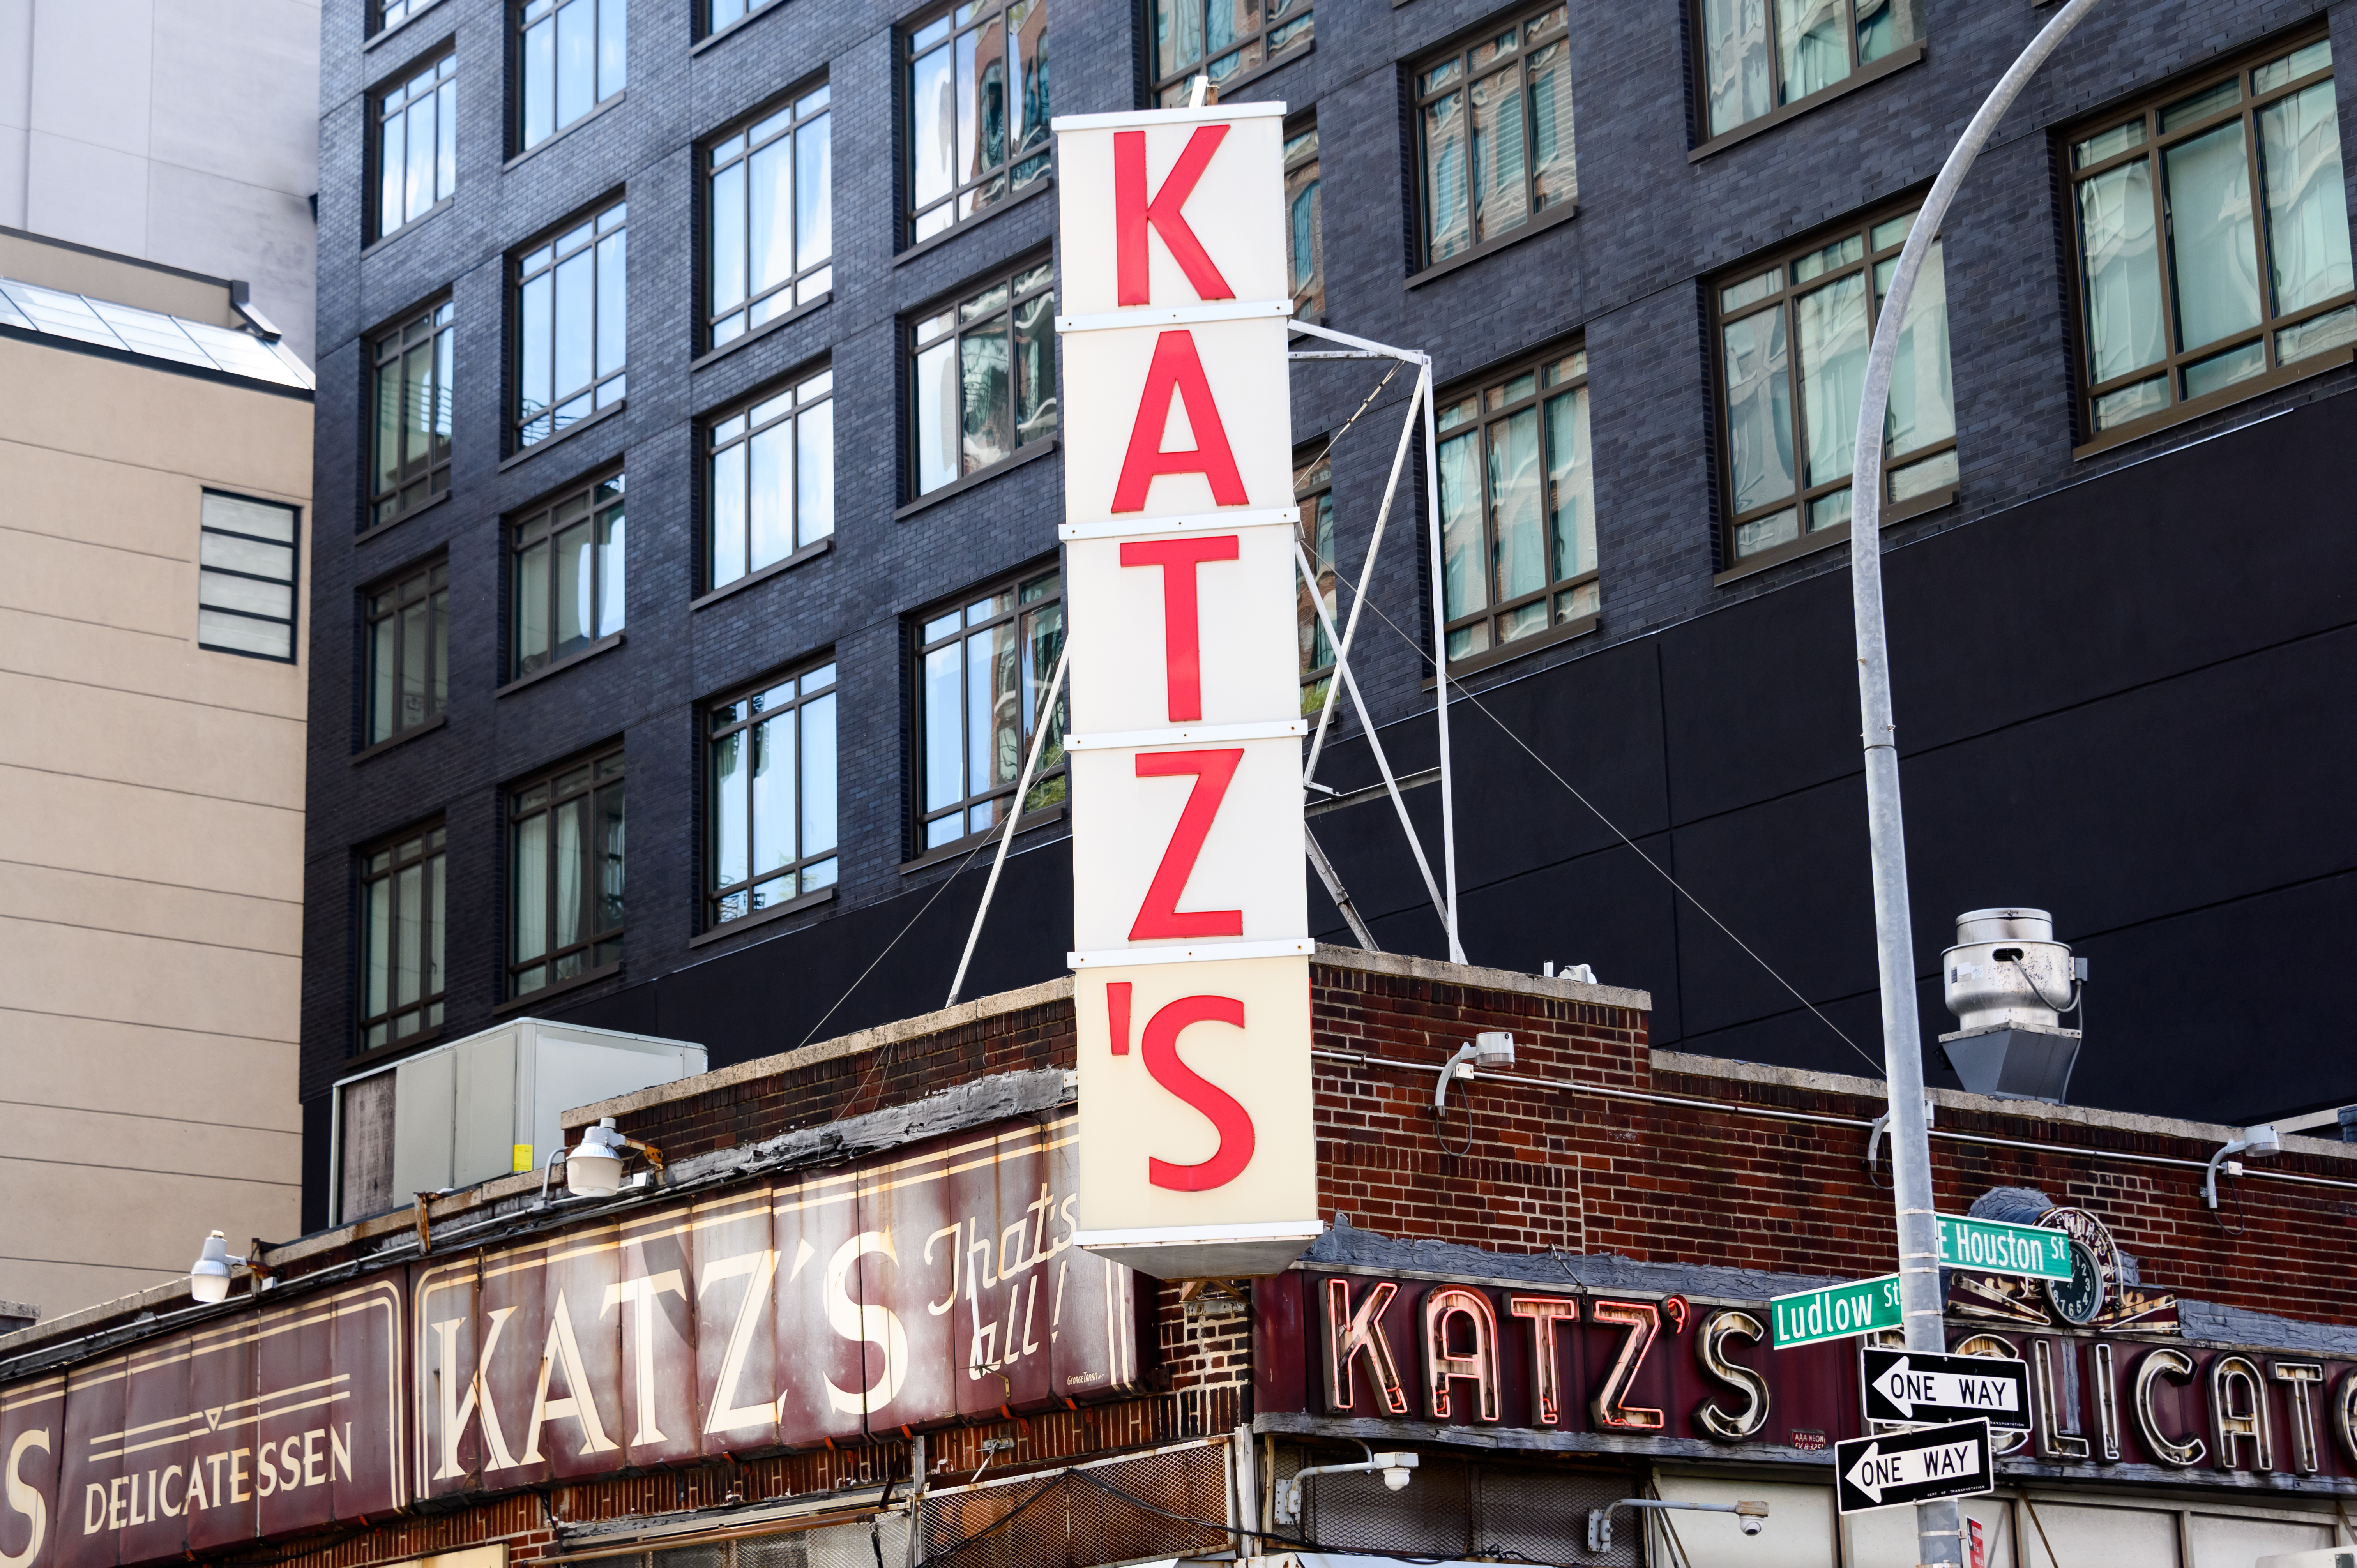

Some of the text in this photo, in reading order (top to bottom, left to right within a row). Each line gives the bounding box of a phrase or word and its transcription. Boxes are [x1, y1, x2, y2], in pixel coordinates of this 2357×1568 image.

[1106, 124, 1255, 1192] KATZ'S
[924, 1182, 1077, 1315] That's
[1937, 1221, 1949, 1259] E
[1956, 1223, 2044, 1271] Houston
[2050, 1236, 2065, 1260] St
[2076, 1254, 2080, 1266] 1
[2081, 1263, 2087, 1276] 2
[2085, 1278, 2090, 1291] 3
[2053, 1290, 2059, 1303] 8
[2082, 1292, 2088, 1305] 4
[1777, 1282, 1900, 1341] Ludlow St
[2060, 1299, 2065, 1312] 7
[2068, 1303, 2074, 1316] 6
[2076, 1300, 2081, 1314] 5
[430, 1225, 908, 1480] KATZ'S
[1320, 1278, 1770, 1441] KATZ'S
[1067, 1375, 1084, 1386] GEORGE
[1083, 1371, 1098, 1383] TARAN
[1891, 1373, 2006, 1406] ONE WAY
[1795, 1433, 1808, 1442] AAA
[1862, 1445, 1968, 1487] ONE WAY
[83, 1421, 352, 1535] DELICATESSEN
